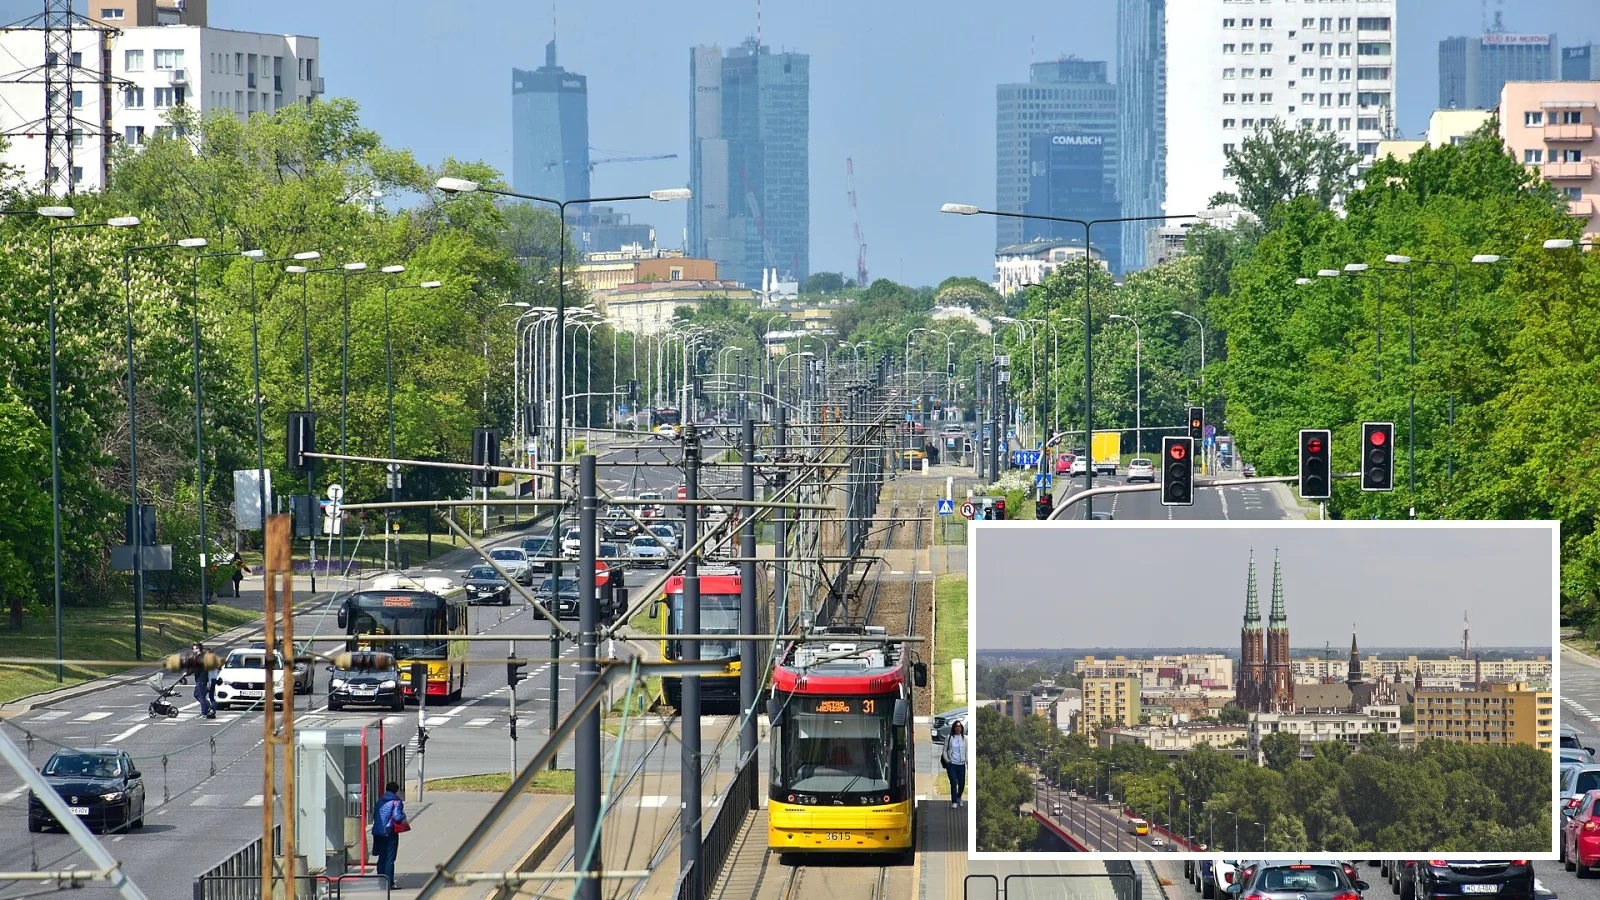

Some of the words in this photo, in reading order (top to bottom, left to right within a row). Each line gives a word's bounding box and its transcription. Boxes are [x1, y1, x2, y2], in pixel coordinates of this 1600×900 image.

[1052, 136, 1102, 145] COMARCH
[862, 700, 874, 713] 31
[825, 831, 851, 841] 3615
